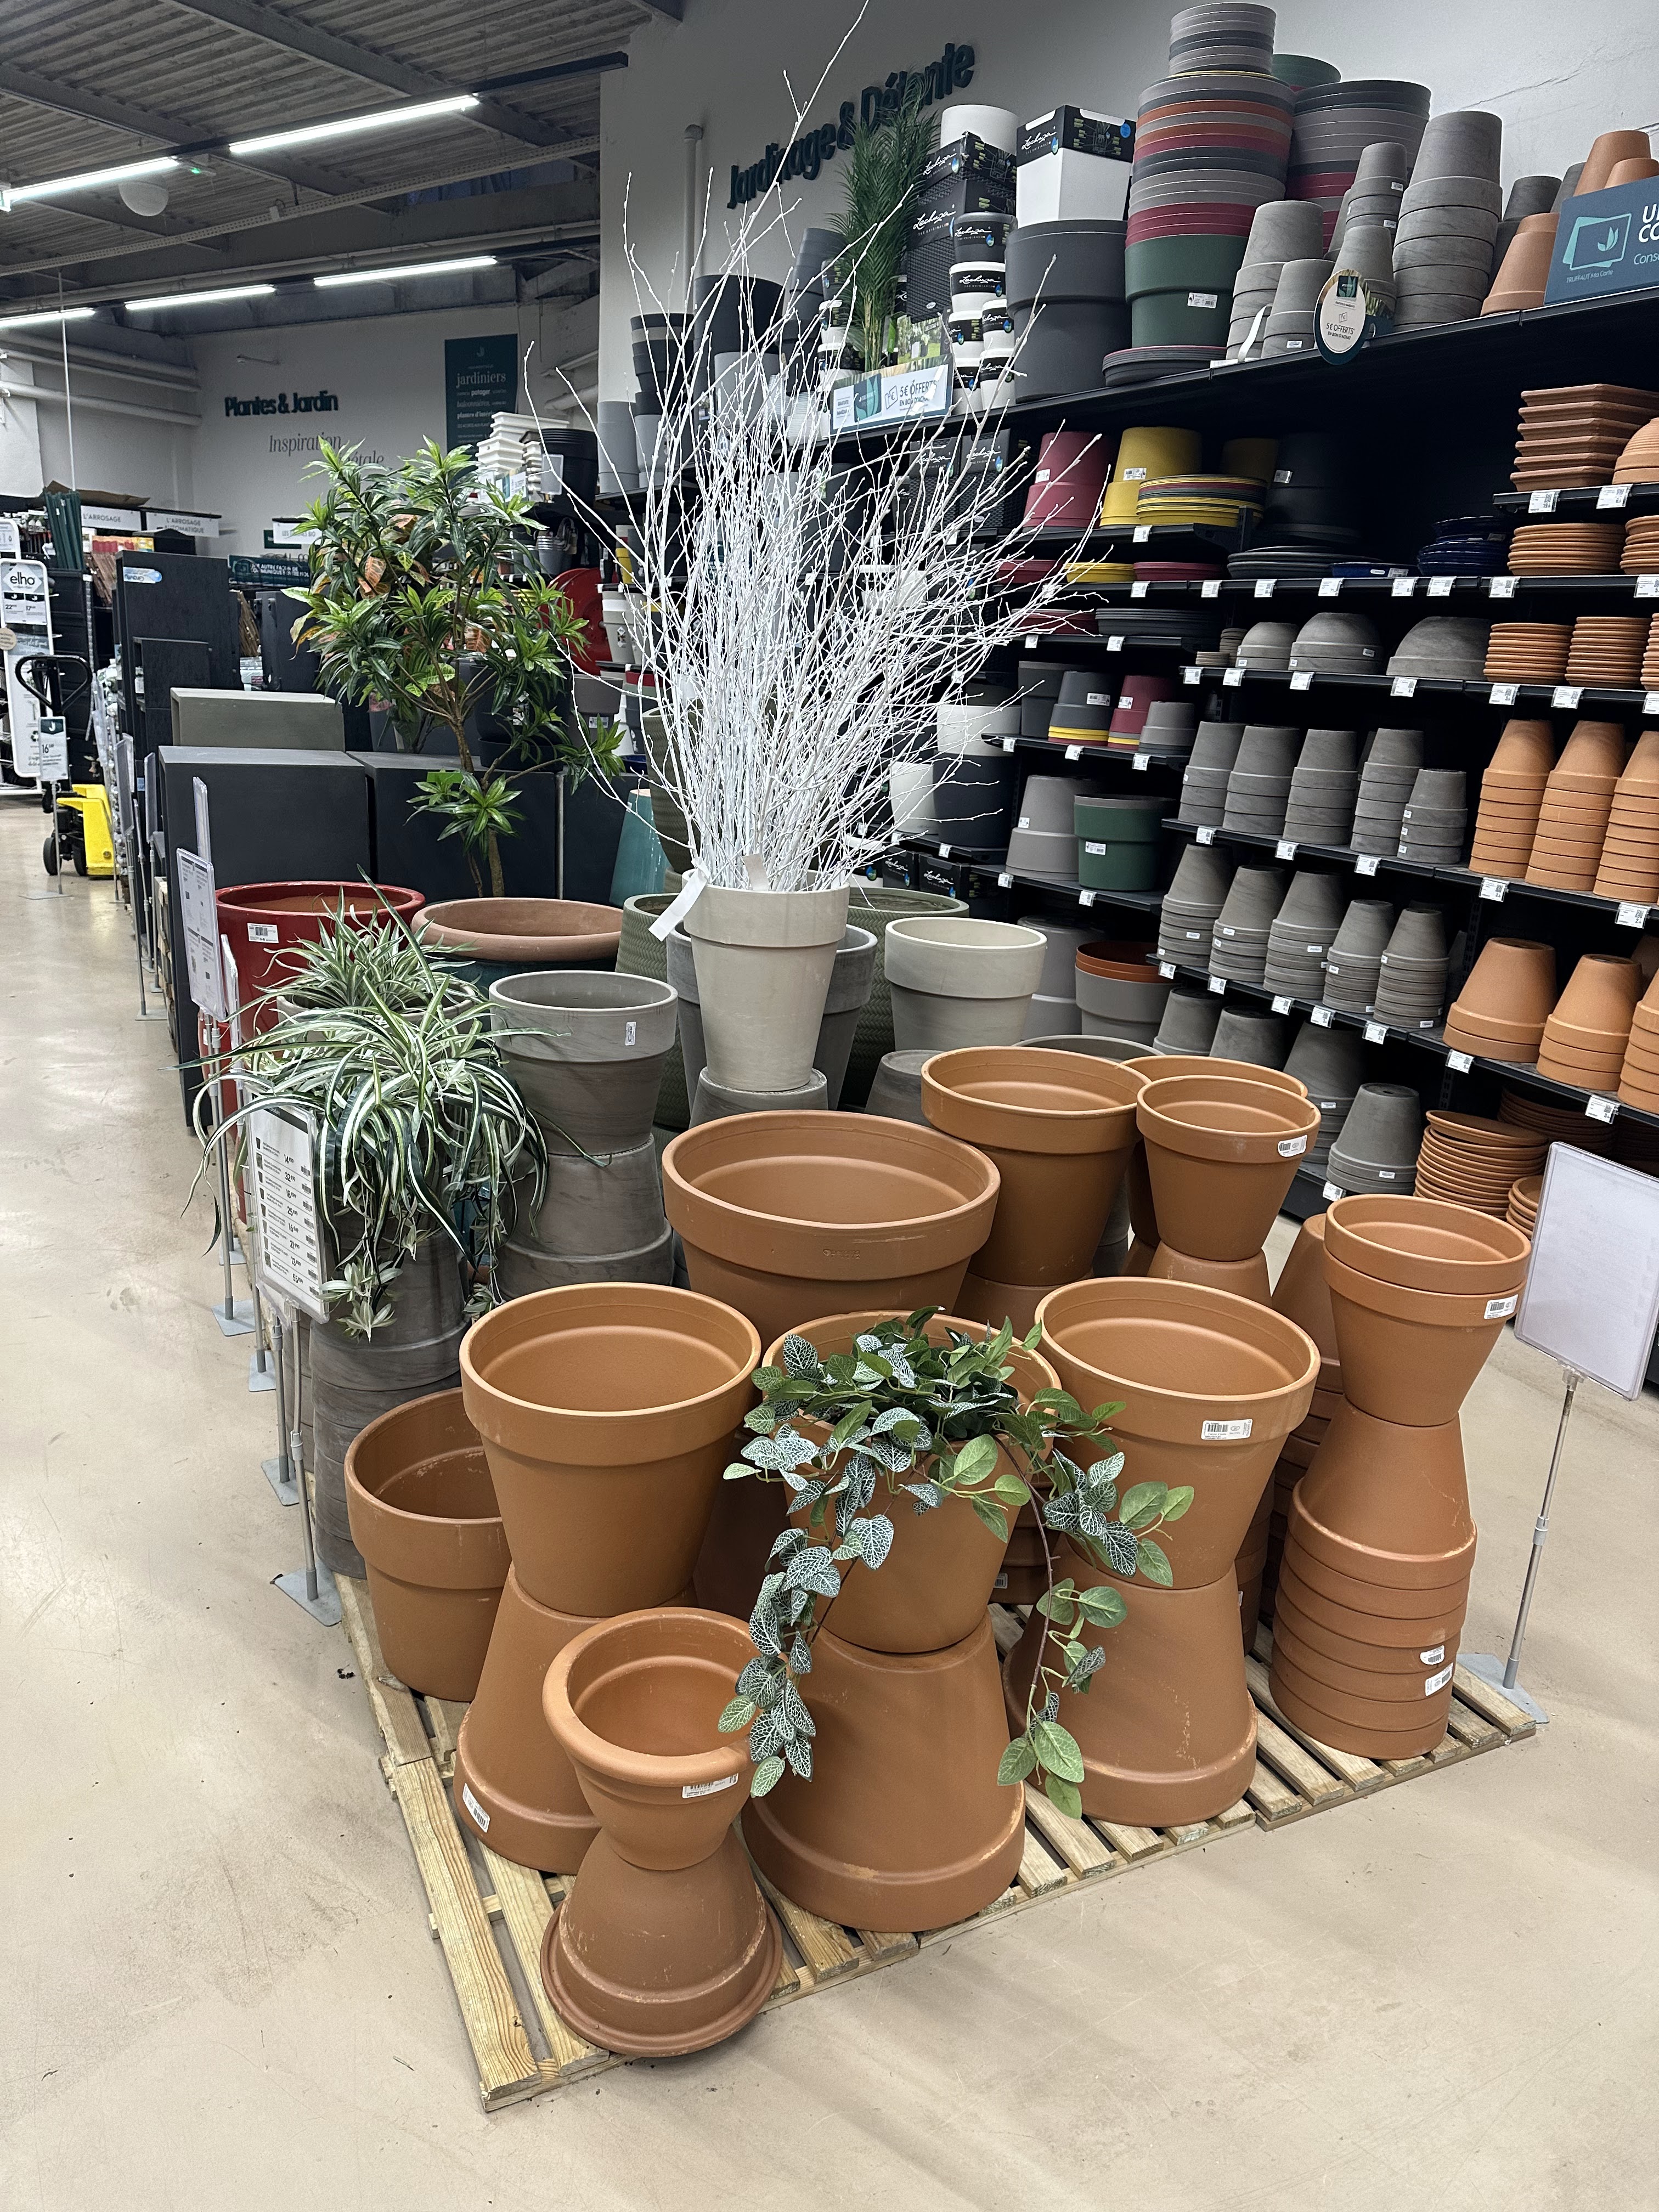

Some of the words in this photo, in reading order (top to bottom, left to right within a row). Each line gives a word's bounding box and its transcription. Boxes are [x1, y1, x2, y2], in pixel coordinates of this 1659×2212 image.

[1021, 131, 1057, 150] Lechuza
[923, 153, 957, 176] Lechuza
[913, 210, 956, 230] Lechuza
[1643, 204, 1659, 223] U
[955, 226, 992, 238] Lechuza
[1634, 253, 1659, 265] Cons
[960, 274, 1001, 284] Lechuza
[456, 371, 506, 388] jardiniers
[224, 396, 276, 417] Plantes
[278, 393, 290, 414] &
[291, 390, 338, 413] Jardin
[10, 571, 35, 585] elho
